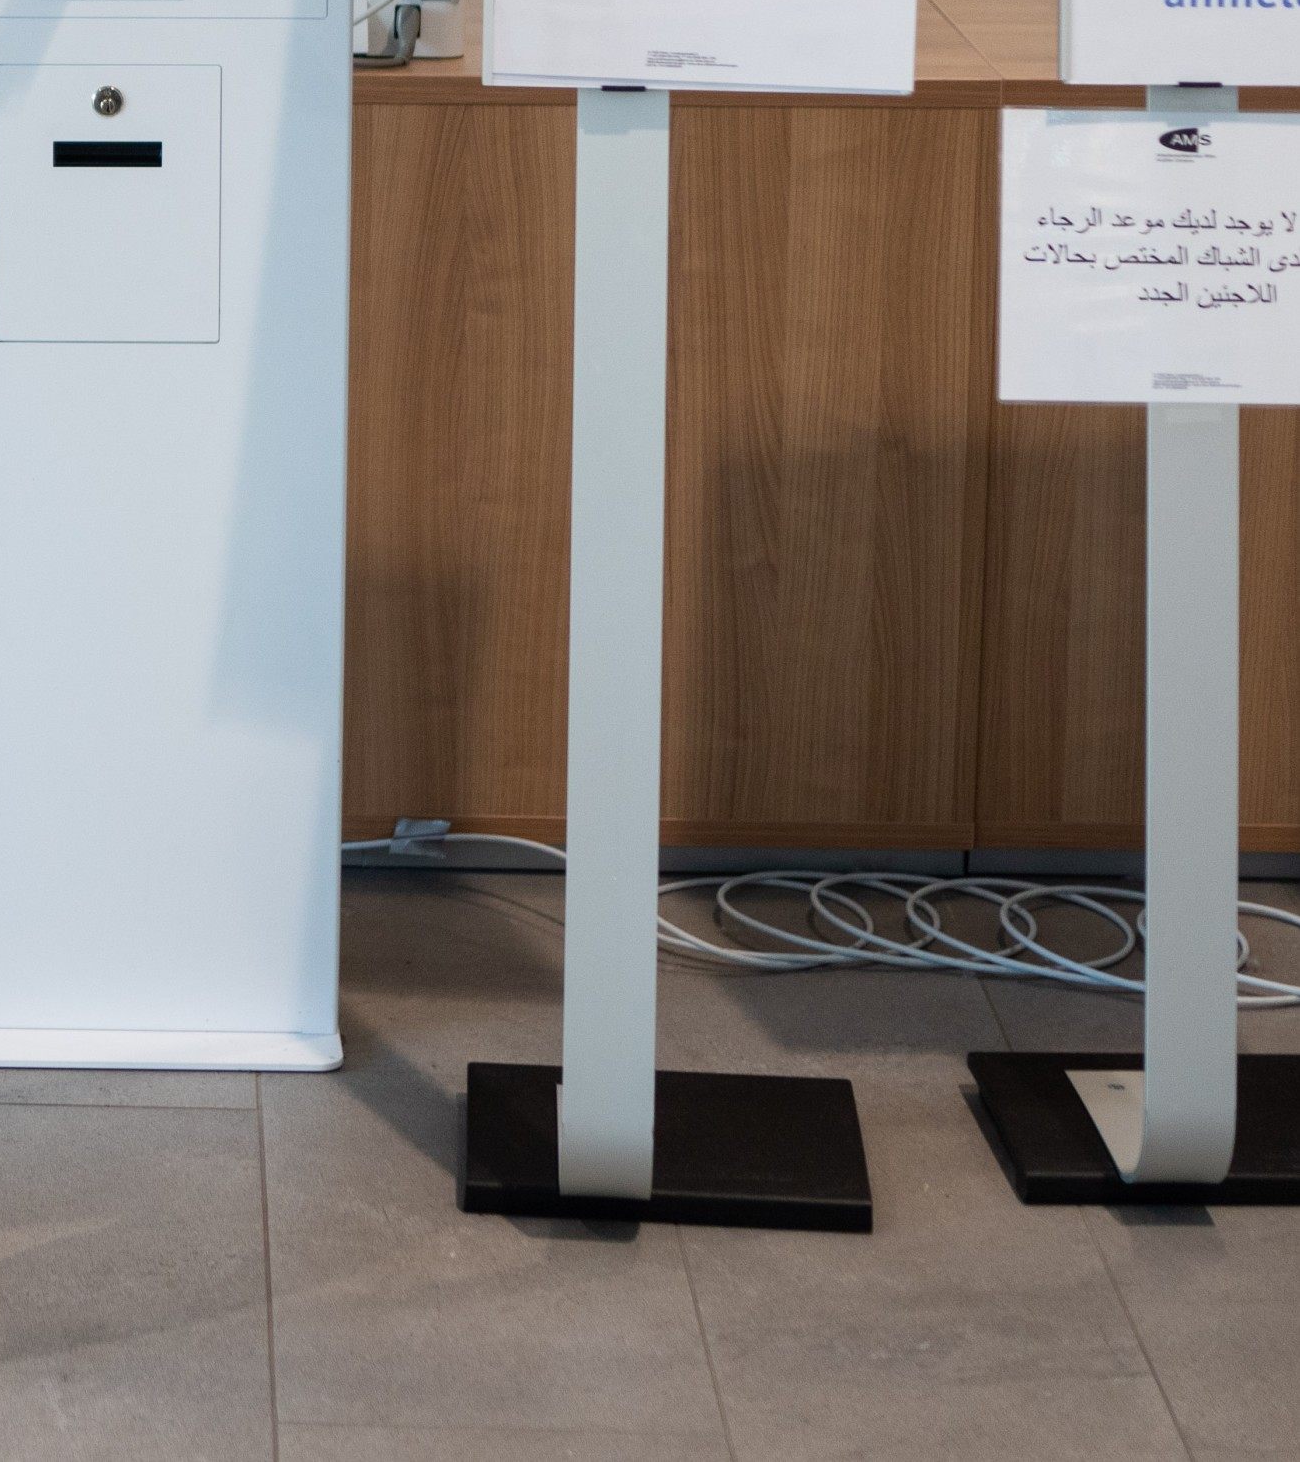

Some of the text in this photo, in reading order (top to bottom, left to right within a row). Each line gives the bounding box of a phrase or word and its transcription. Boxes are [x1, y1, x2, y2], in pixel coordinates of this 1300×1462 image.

[1037, 206, 1299, 238] لا يوجد لديك موعد الرجاء
[1023, 243, 1300, 273] دى الشباك المختص بحالات
[1137, 281, 1190, 307] الجدد
